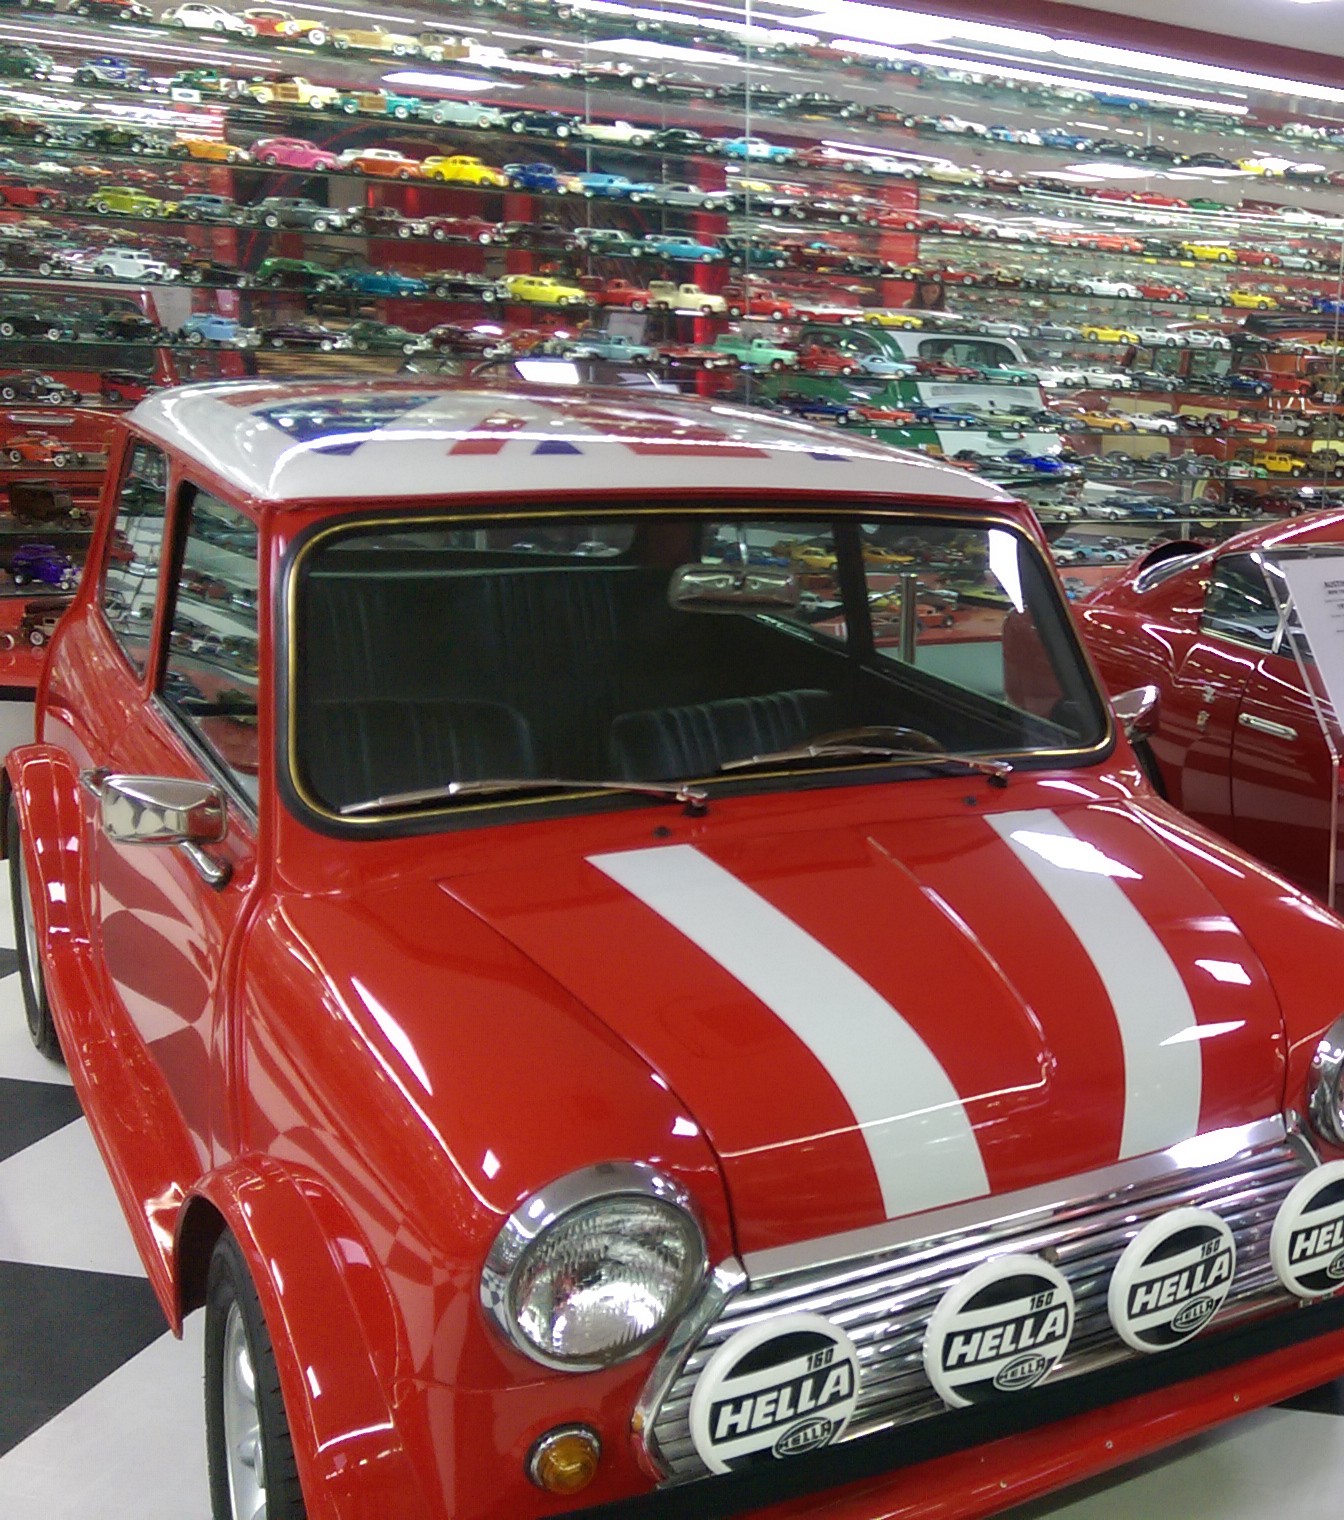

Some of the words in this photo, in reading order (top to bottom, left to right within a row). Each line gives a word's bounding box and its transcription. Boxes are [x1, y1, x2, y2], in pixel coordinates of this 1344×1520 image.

[1201, 1238, 1221, 1259] 160
[1130, 1251, 1230, 1315] HELLA
[1030, 1292, 1054, 1311] 160
[1176, 1300, 1214, 1323] HELLA
[946, 1307, 1066, 1367] HELLA
[807, 1348, 834, 1372] 160
[1001, 1357, 1046, 1380] HELLA
[715, 1363, 850, 1440] HELLA
[779, 1421, 832, 1449] HELLA
